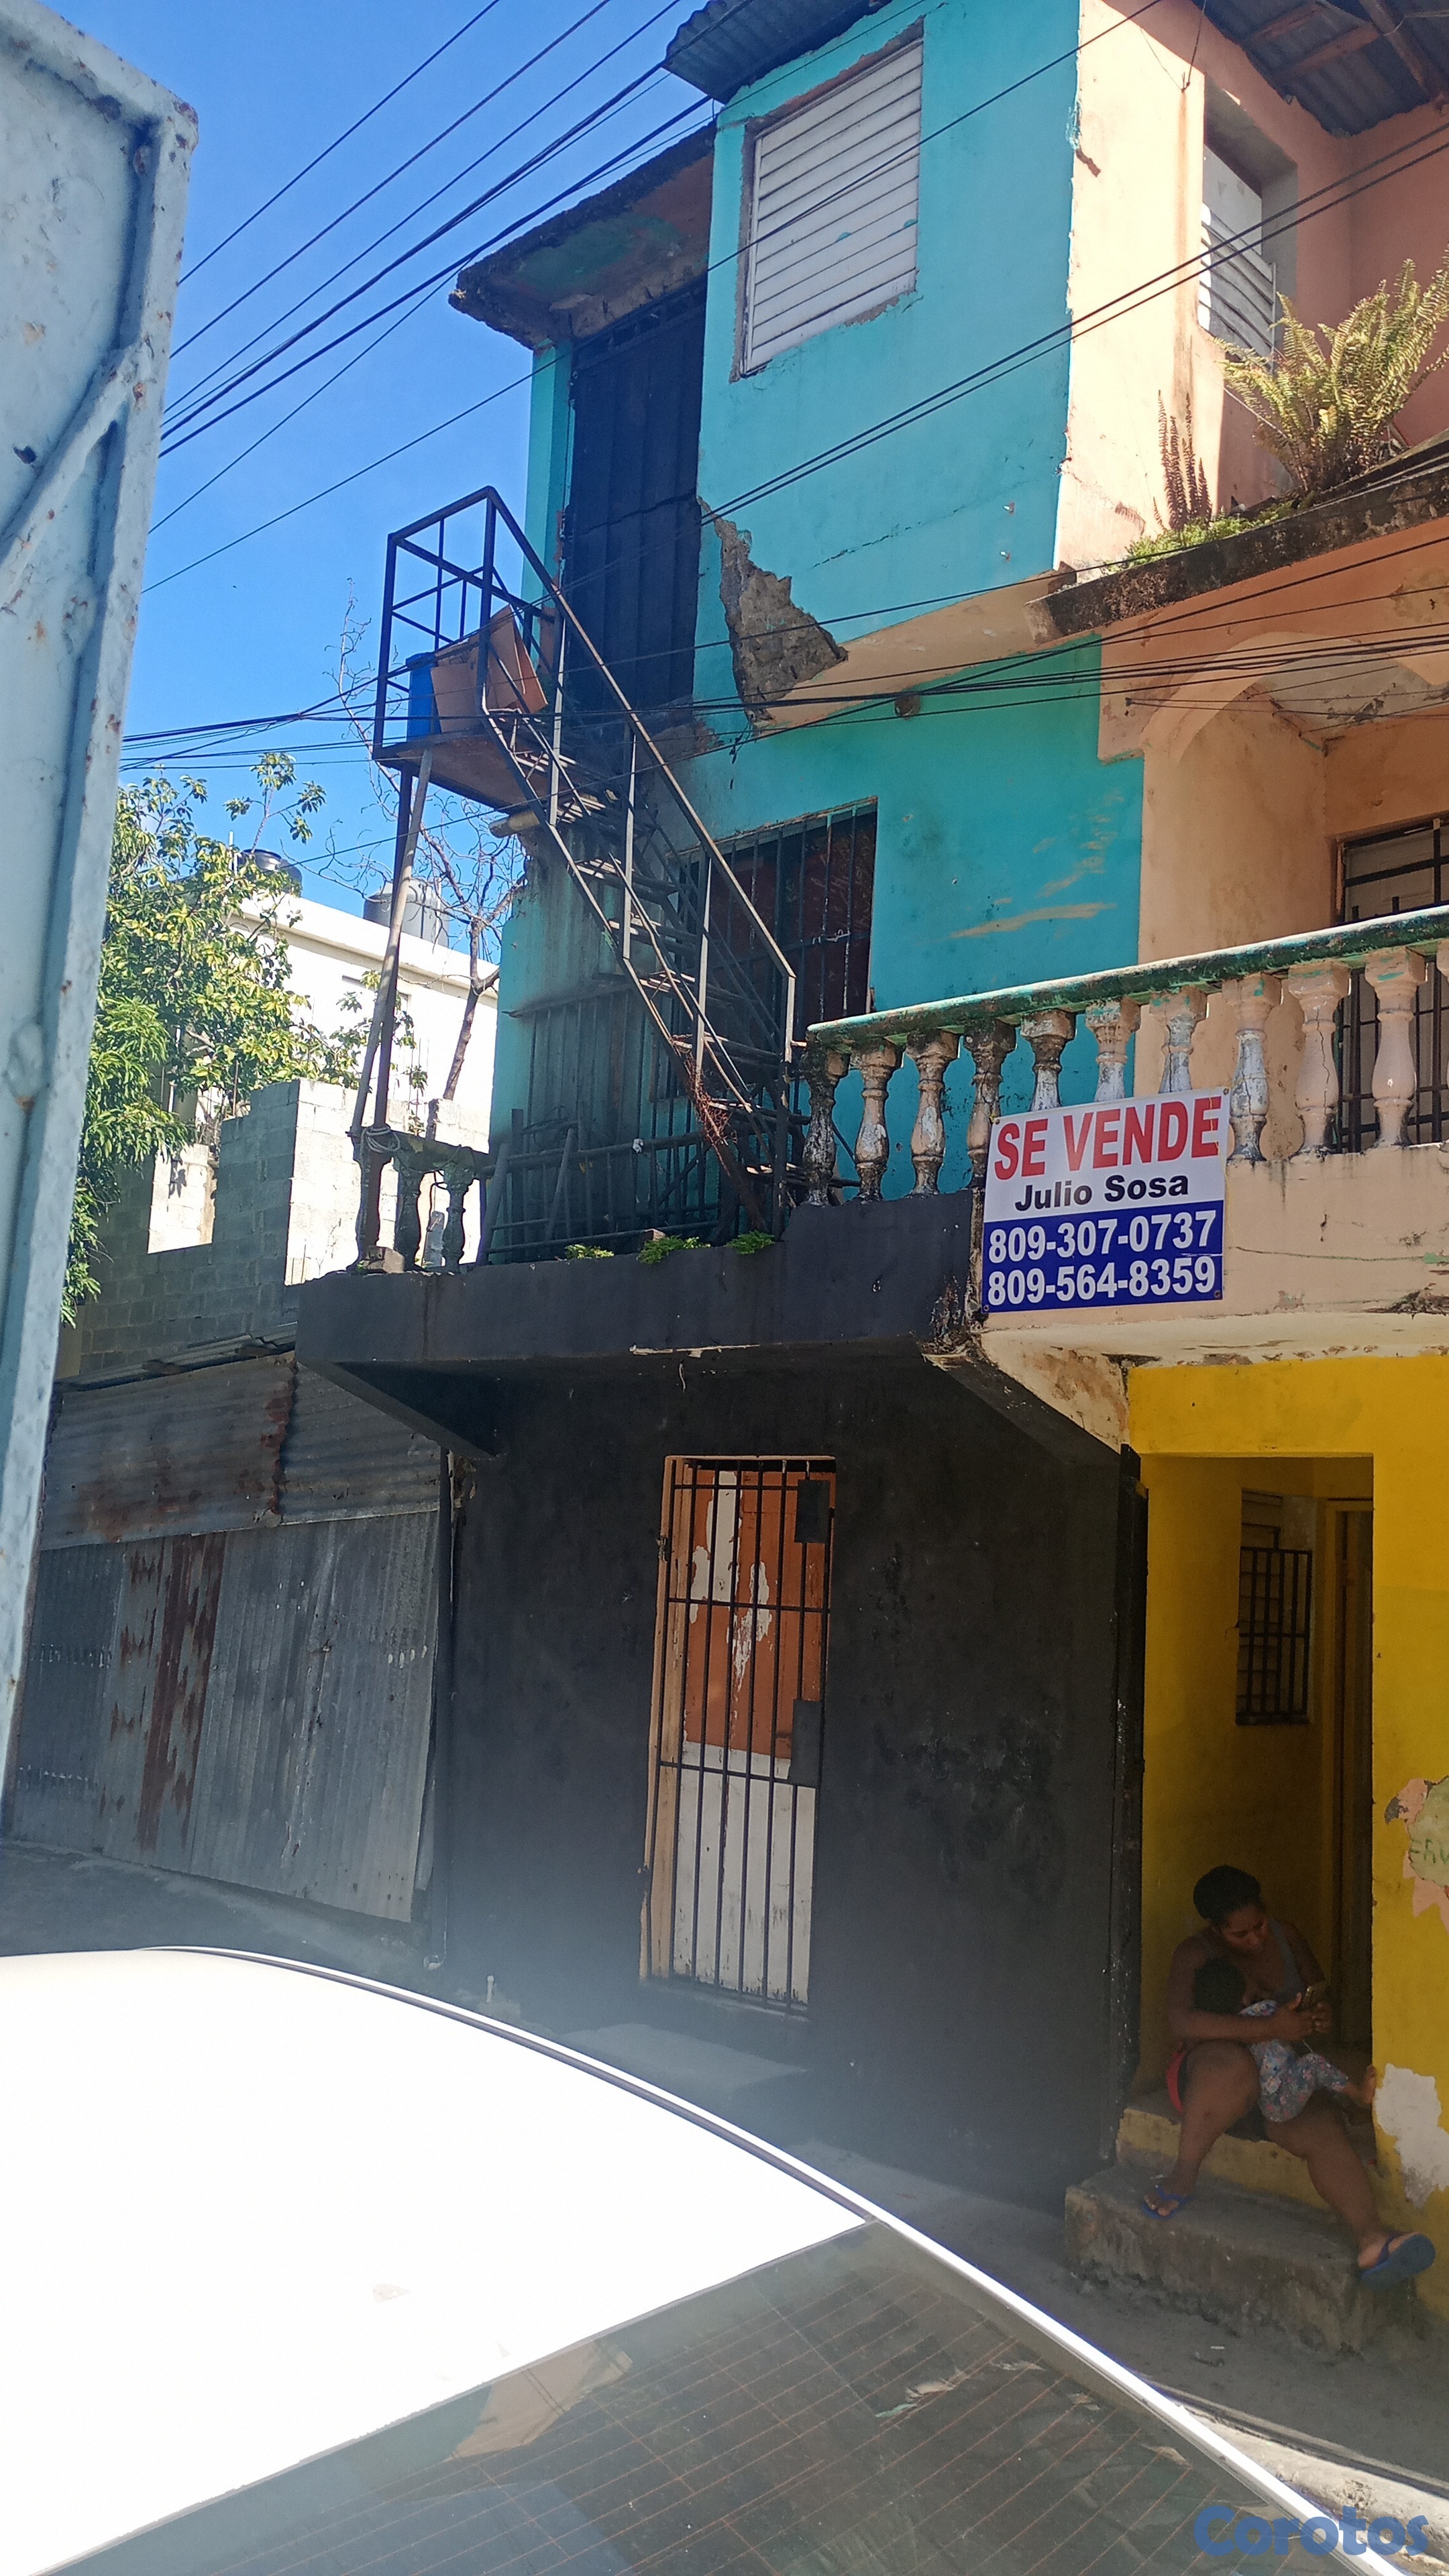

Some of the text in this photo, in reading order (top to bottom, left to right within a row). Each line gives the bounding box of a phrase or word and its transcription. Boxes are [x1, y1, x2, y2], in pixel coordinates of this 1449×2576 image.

[994, 1095, 1222, 1181] SE VENDE
[1015, 1174, 1188, 1212] Julio Sosa
[988, 1210, 1216, 1263] 809-307-0737
[987, 1255, 1216, 1305] 809-564-8359
